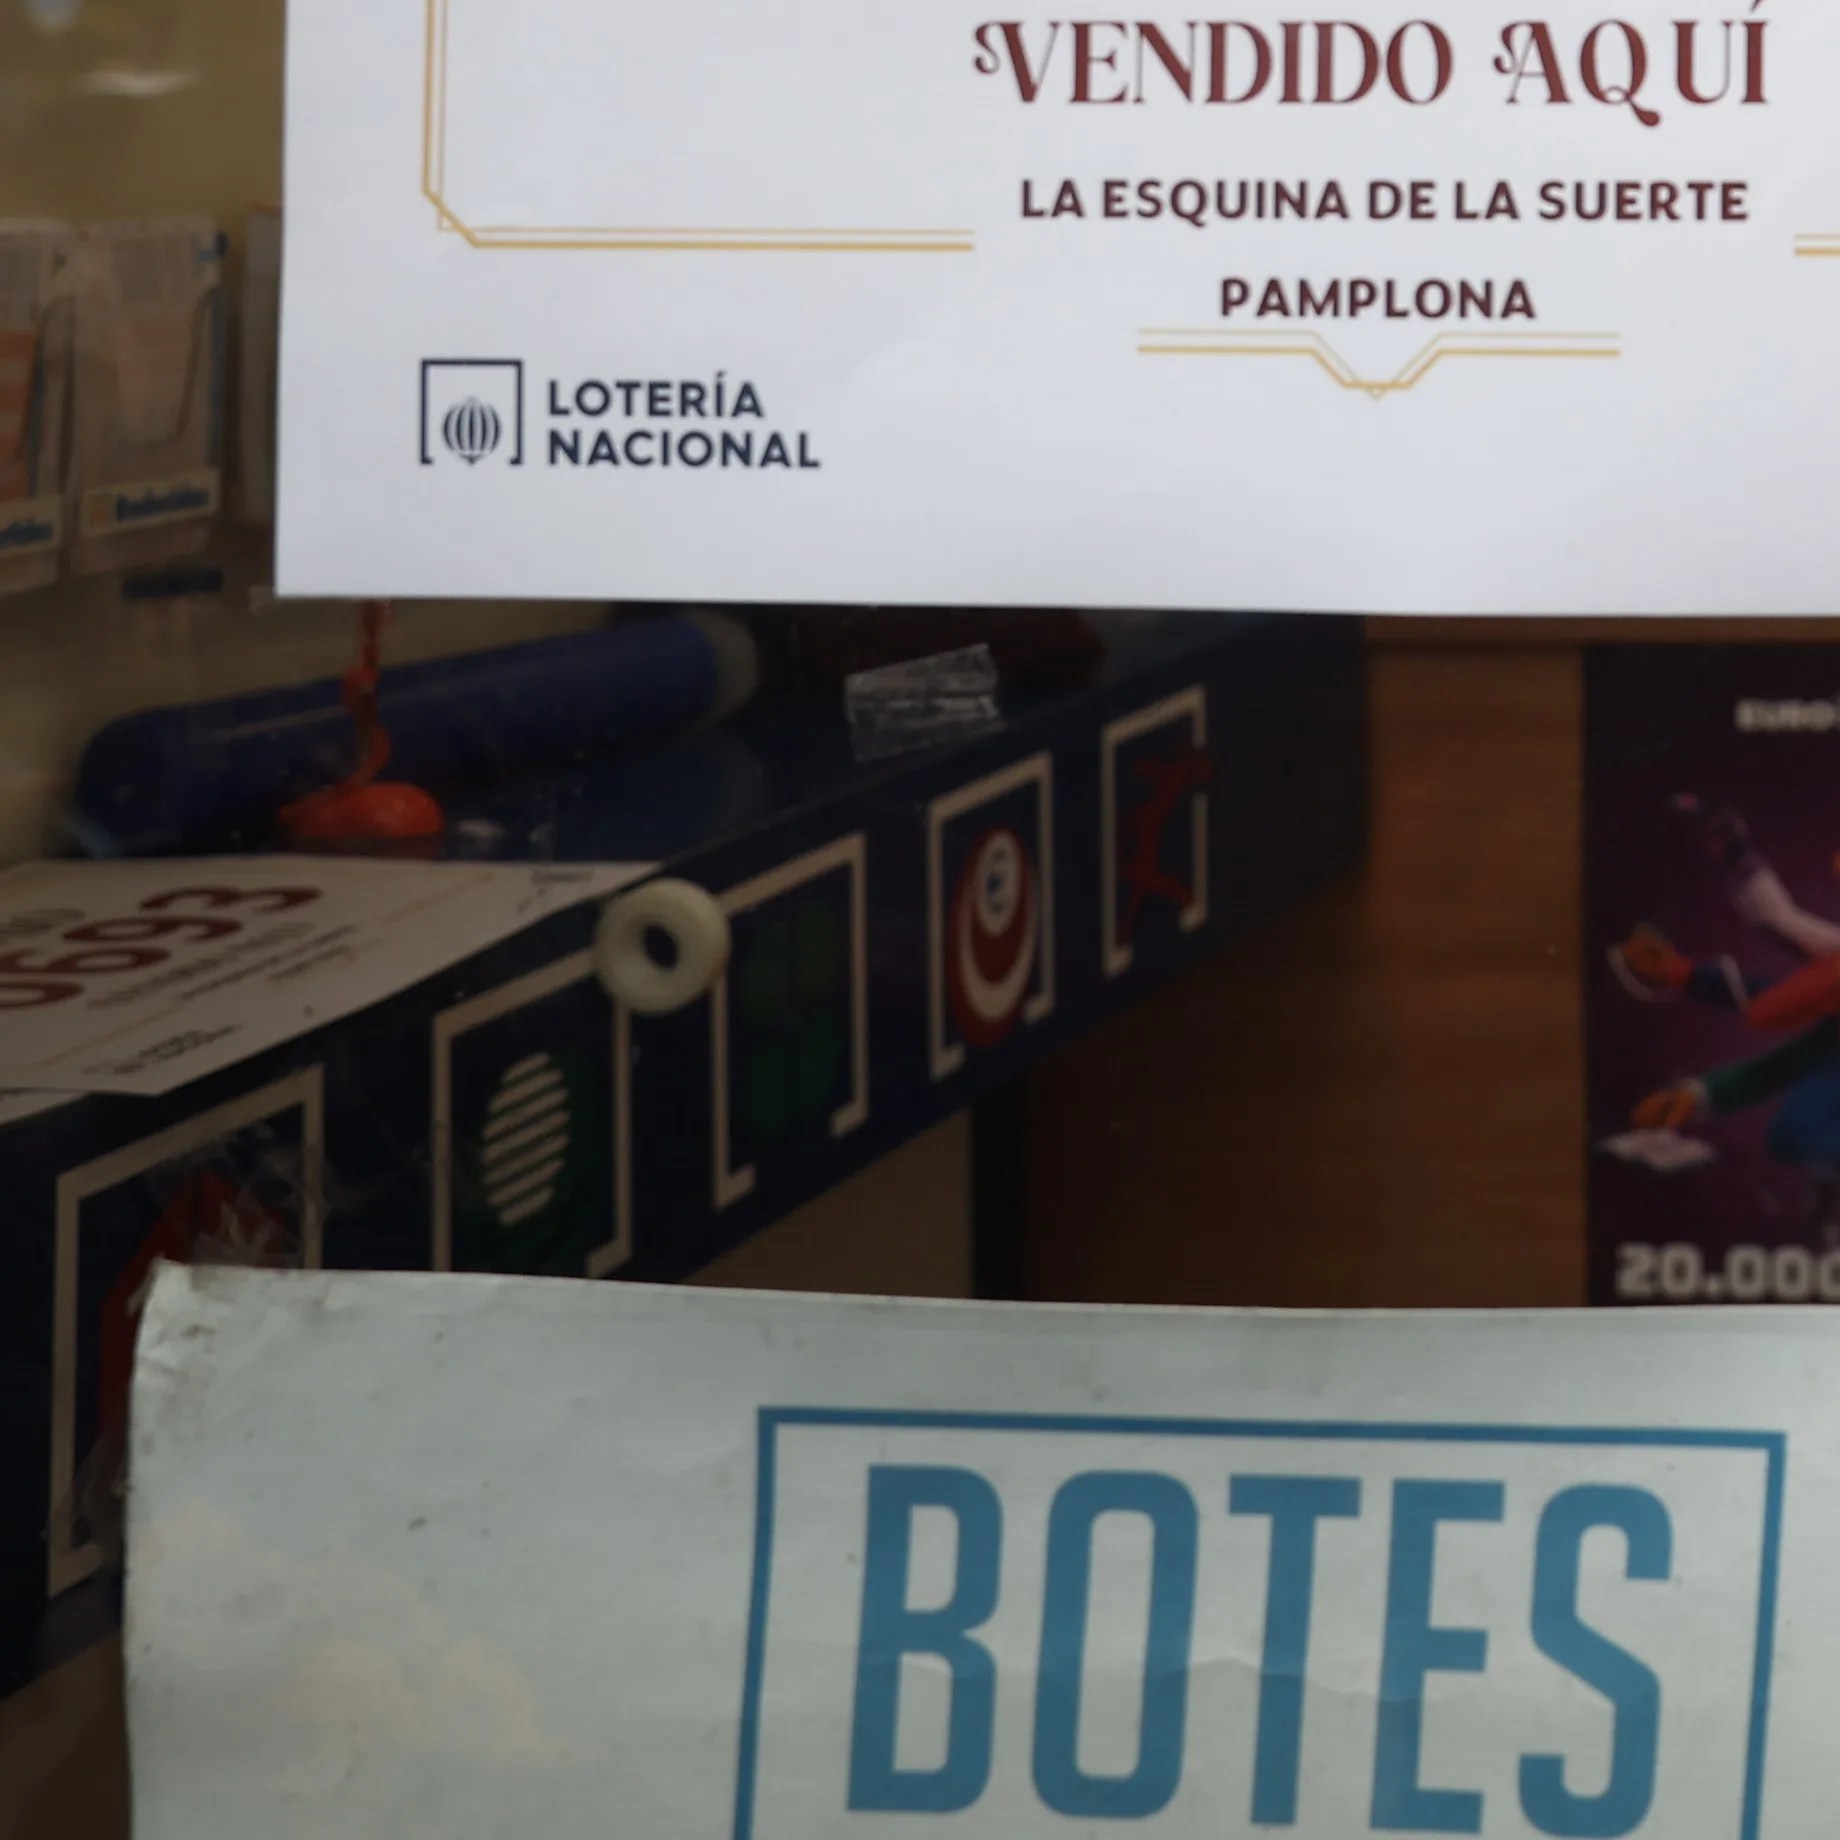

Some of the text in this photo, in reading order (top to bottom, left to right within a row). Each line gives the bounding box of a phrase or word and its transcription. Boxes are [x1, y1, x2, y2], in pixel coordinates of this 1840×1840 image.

[974, 18, 1455, 107] VENDIDO
[1020, 178, 1750, 228] LA ESQUINA DE LA SUERTE
[1220, 277, 1538, 321] PAMPLONA
[547, 370, 764, 419] LOTERÍA
[547, 429, 822, 469] NACIONAL
[845, 1463, 1675, 1840] BOTES
